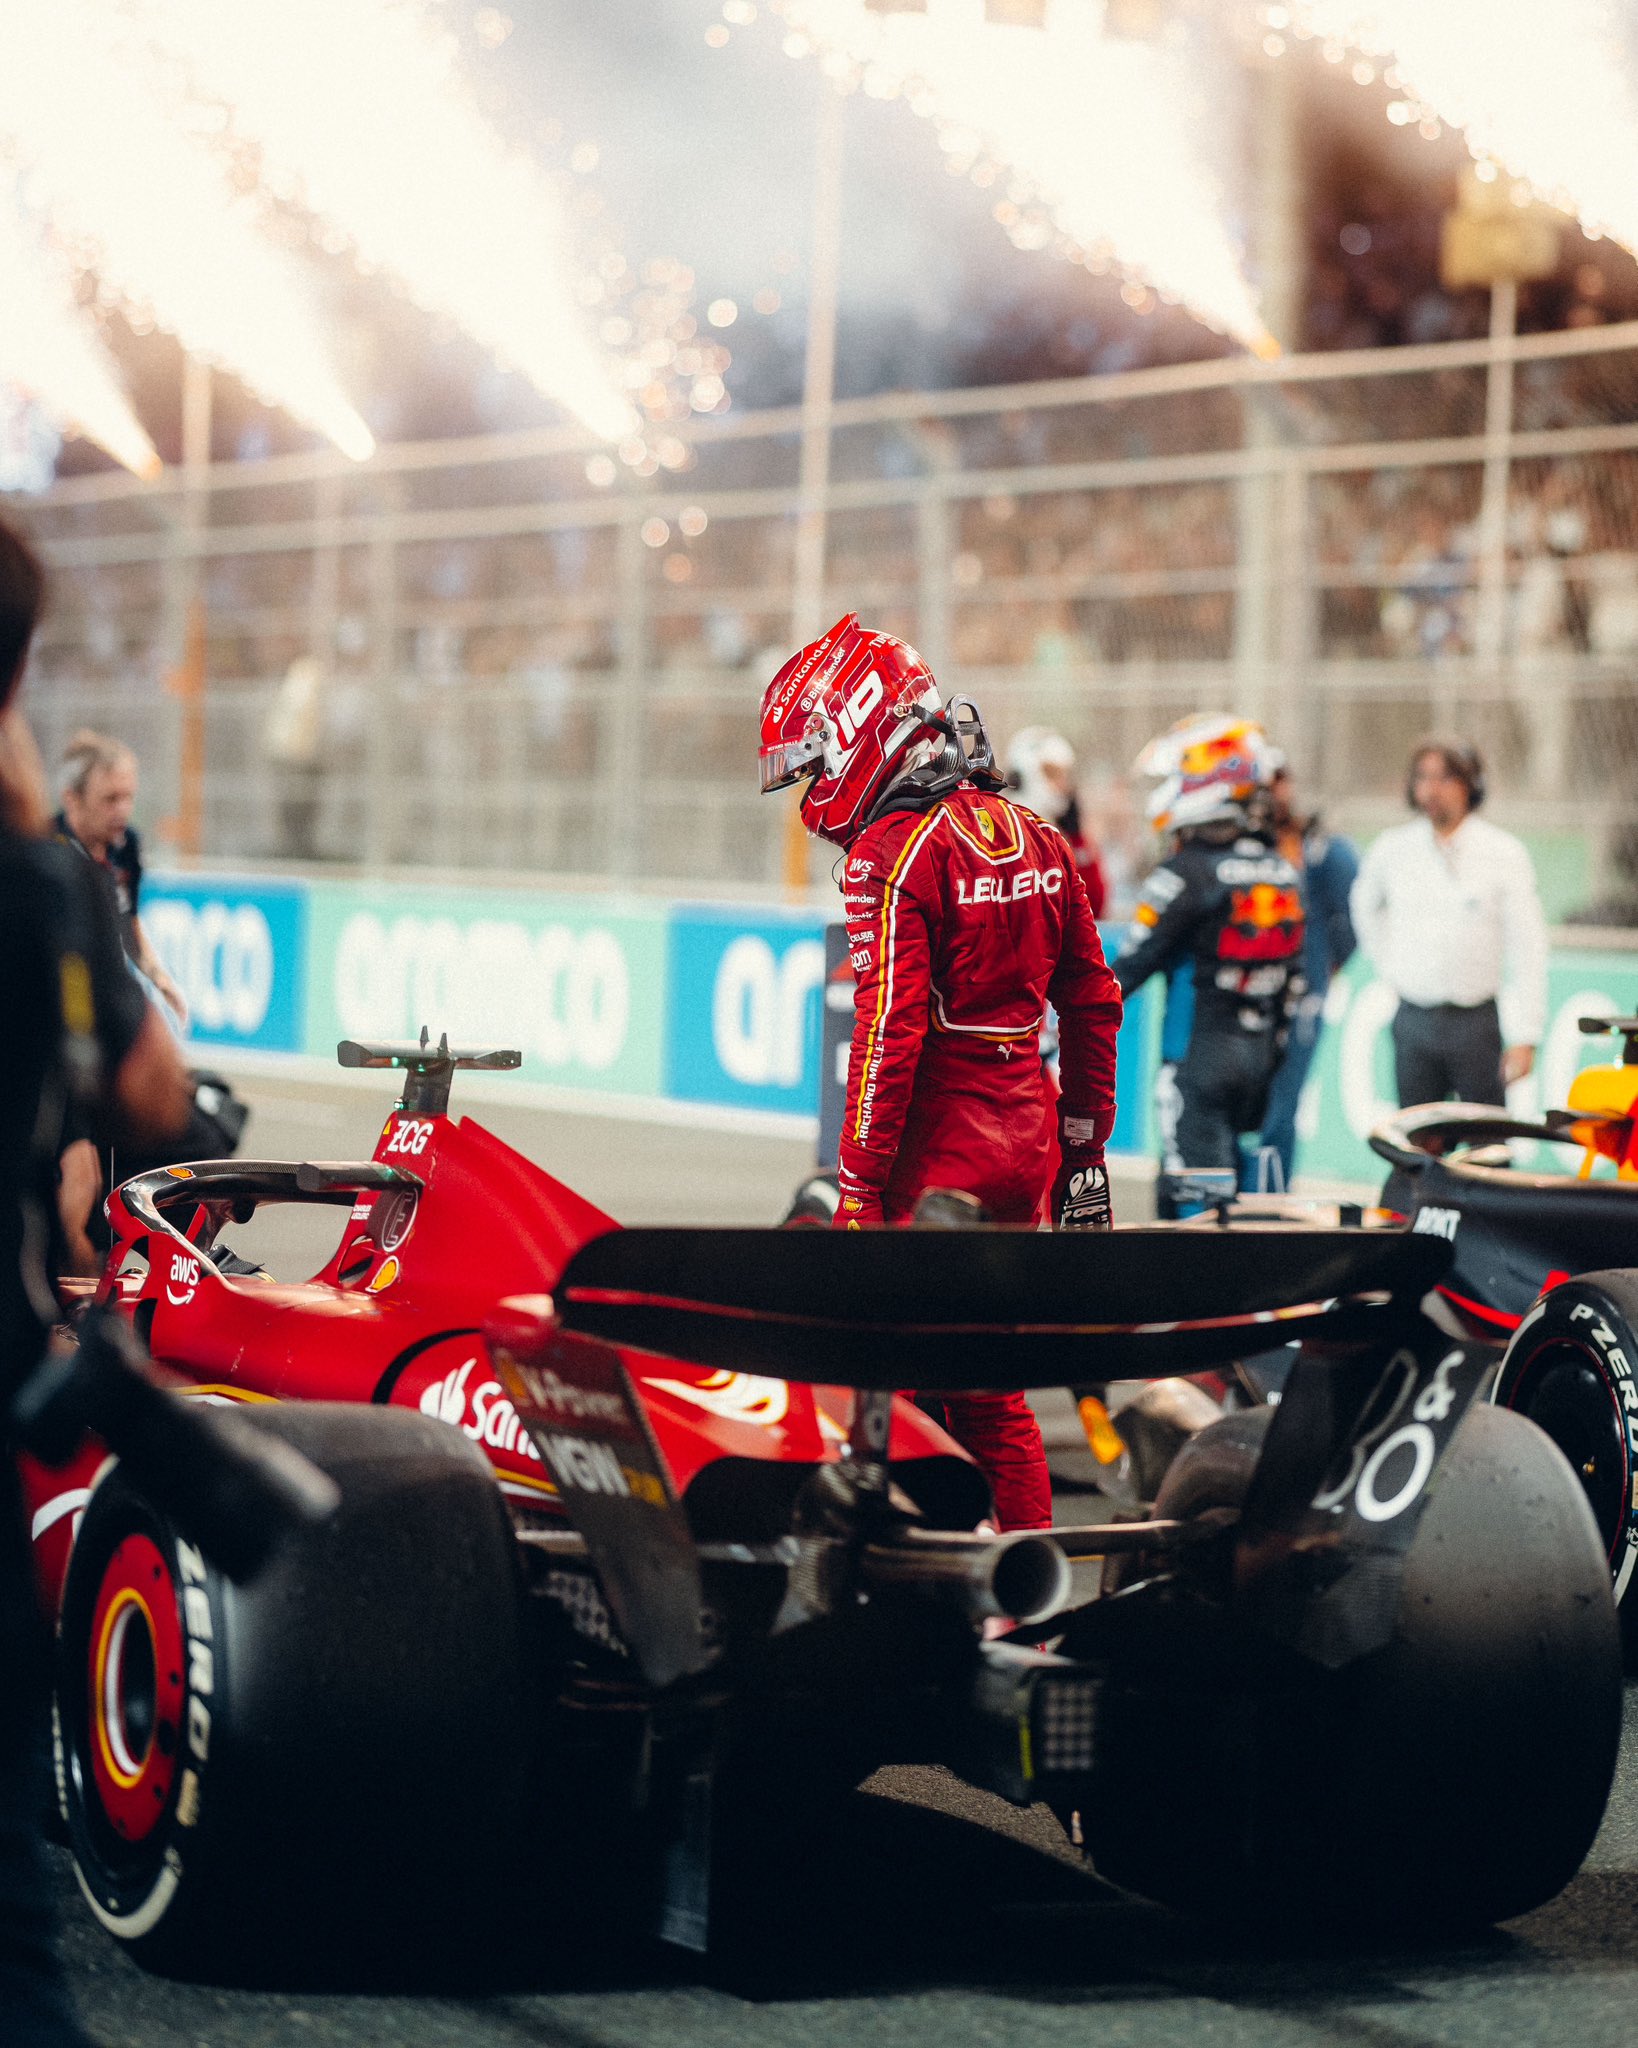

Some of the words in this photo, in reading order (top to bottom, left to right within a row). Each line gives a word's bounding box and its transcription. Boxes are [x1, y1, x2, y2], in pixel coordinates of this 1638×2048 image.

[781, 636, 832, 706] Santander
[809, 647, 846, 699] Bitdefender
[858, 1083, 877, 1137] RICHARD
[868, 1043, 885, 1082] MILLE
[387, 1119, 434, 1155] ZCG
[170, 1253, 200, 1286] aws
